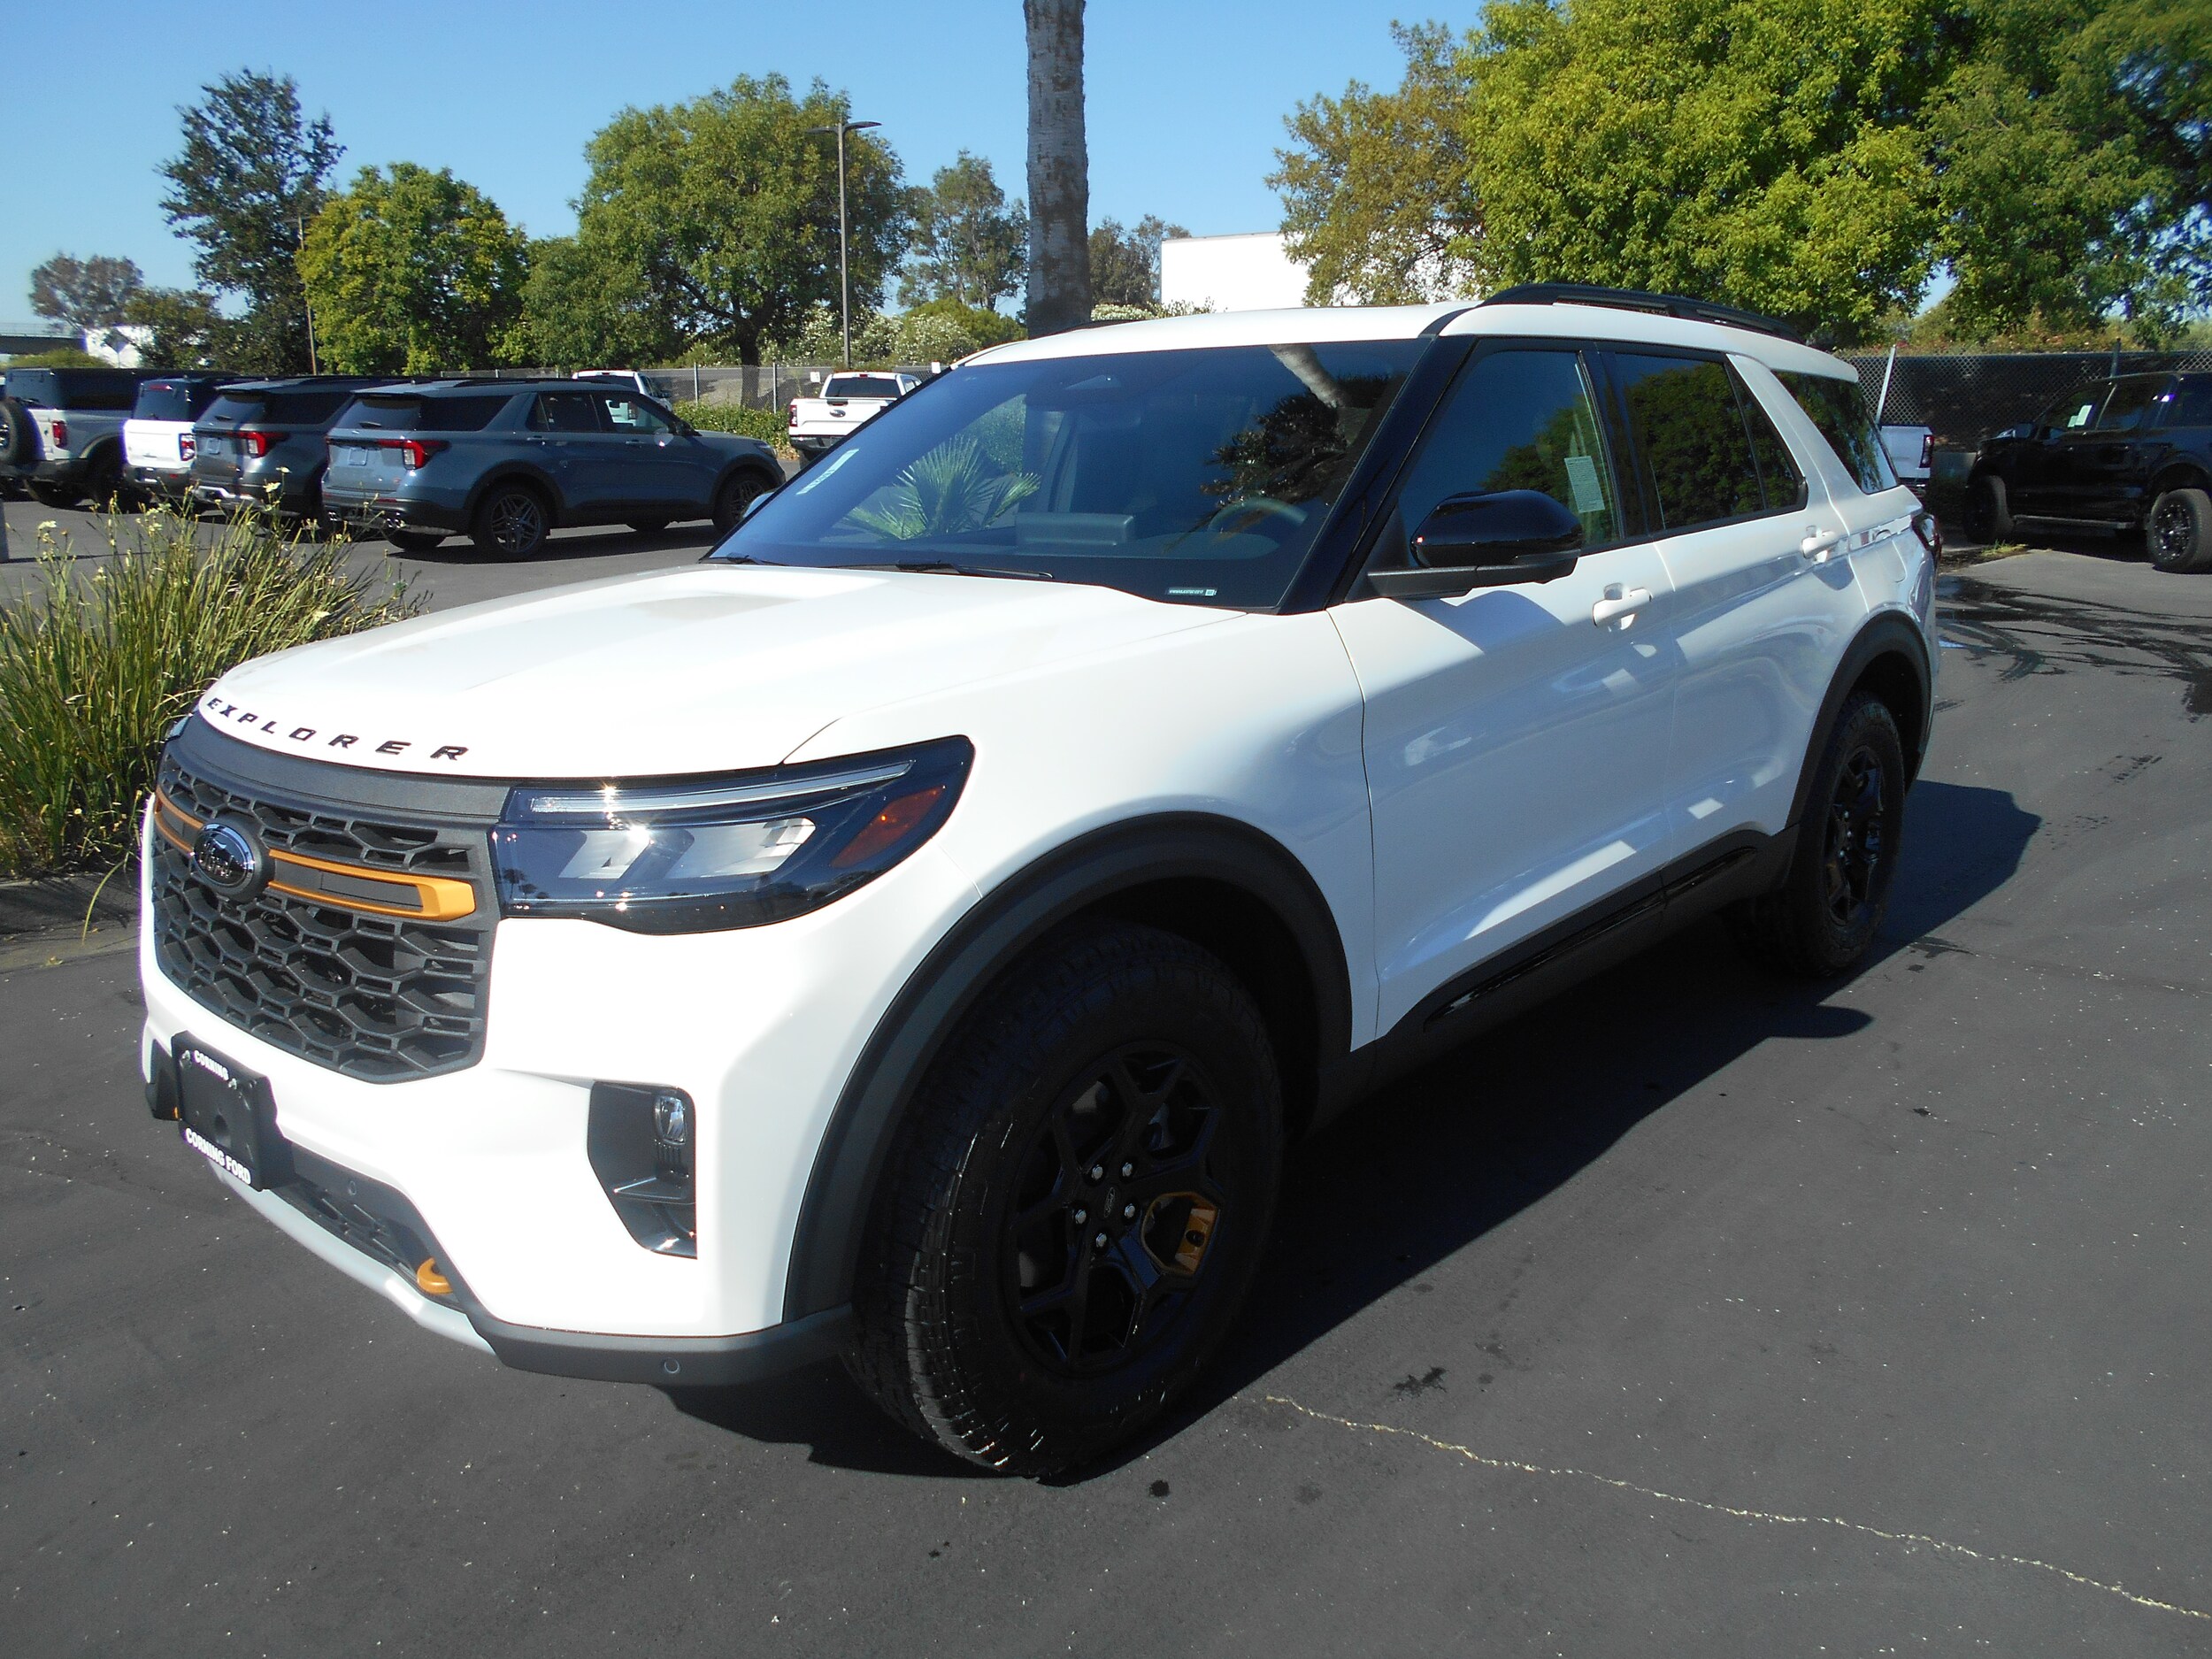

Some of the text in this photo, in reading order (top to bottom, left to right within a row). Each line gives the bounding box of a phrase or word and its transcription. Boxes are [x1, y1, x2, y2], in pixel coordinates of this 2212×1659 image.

[206, 697, 469, 761] EXPLORER
[194, 1050, 228, 1080] CORNING
[186, 1128, 251, 1184] CORNING FORD
